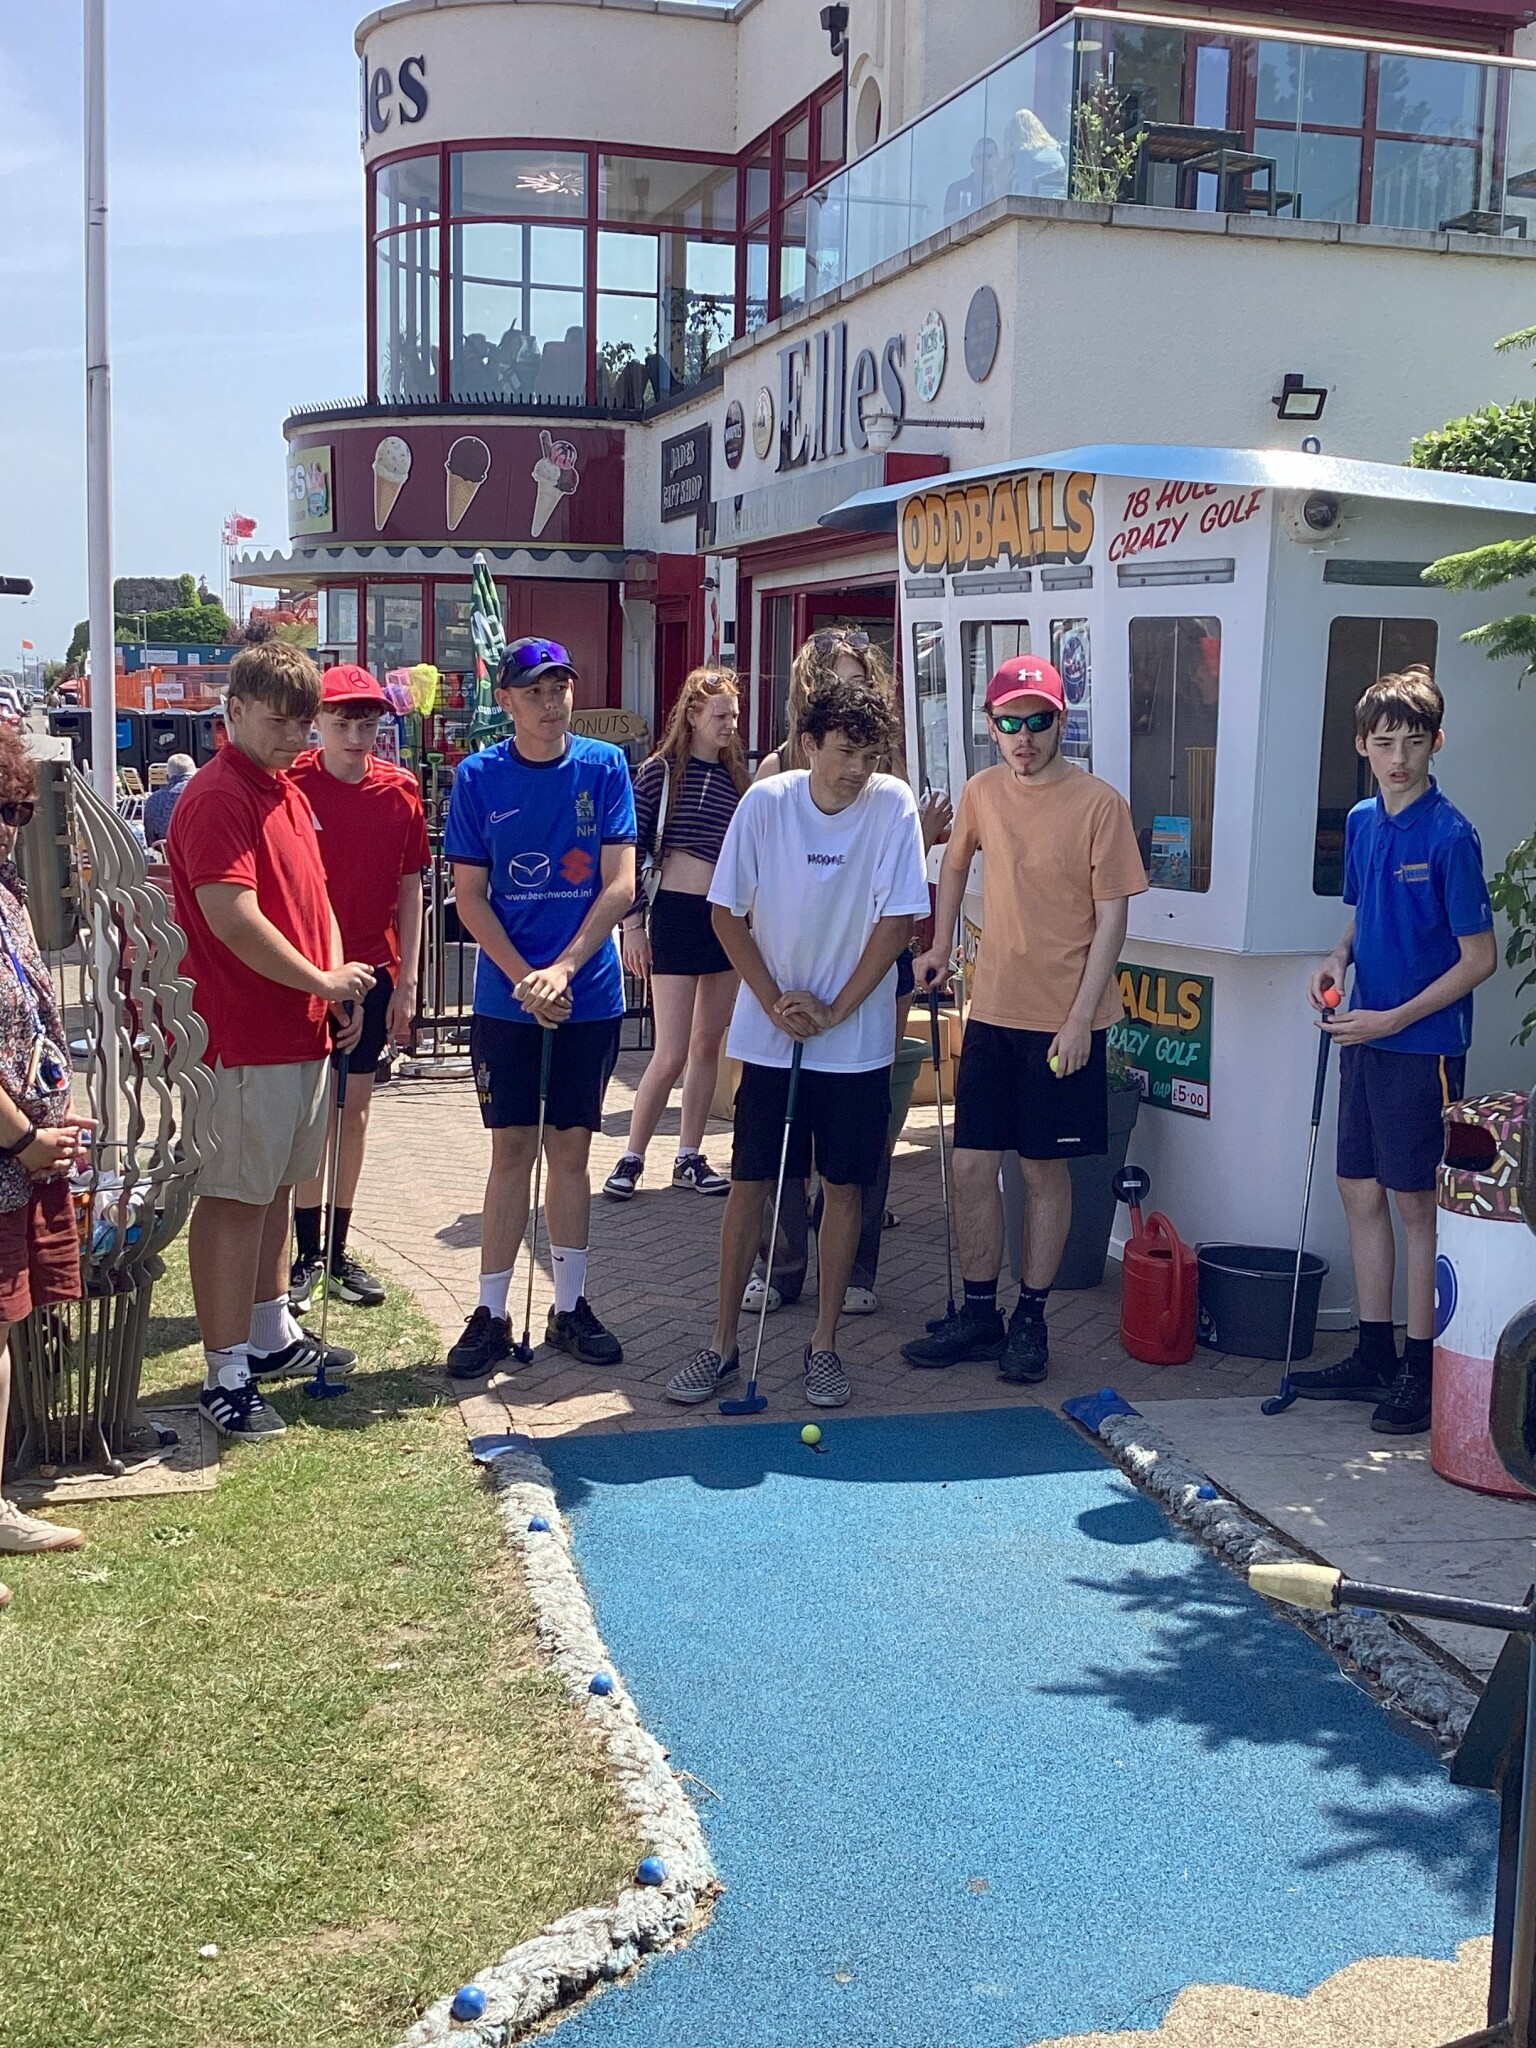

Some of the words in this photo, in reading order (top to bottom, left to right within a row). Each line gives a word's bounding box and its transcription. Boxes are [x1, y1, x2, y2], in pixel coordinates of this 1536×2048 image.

[775, 320, 904, 473] Elles
[670, 440, 695, 478] JADES
[662, 482, 680, 510] GIFT
[680, 475, 703, 504] SHOP
[1123, 487, 1150, 522] 18
[903, 471, 1096, 574] ODDBALLS
[1107, 512, 1189, 562] CRAZY
[1200, 487, 1266, 533] GOLF
[569, 715, 630, 736] ONUTS
[576, 824, 597, 838] NH
[1106, 1024, 1149, 1056] RAZY
[1156, 1036, 1202, 1067] GOLF
[1153, 1081, 1171, 1099] OAP
